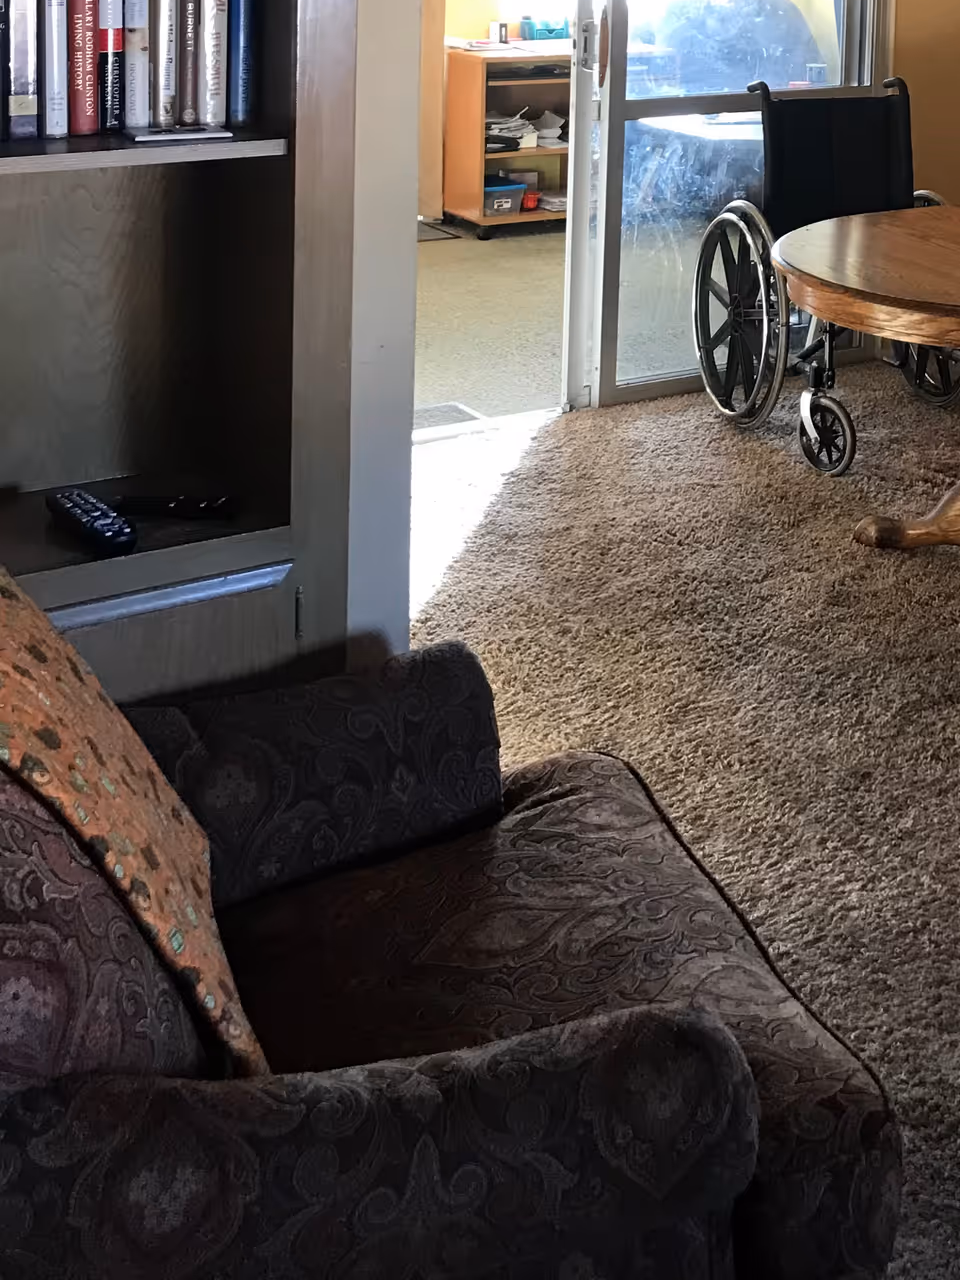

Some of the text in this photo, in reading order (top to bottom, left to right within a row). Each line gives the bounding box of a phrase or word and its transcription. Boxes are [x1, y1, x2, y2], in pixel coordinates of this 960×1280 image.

[186, 3, 195, 51] BURNETT
[74, 14, 83, 92] LIVING HISTORY
[85, 31, 94, 71] RODHAM
[85, 75, 94, 116] CLINTON
